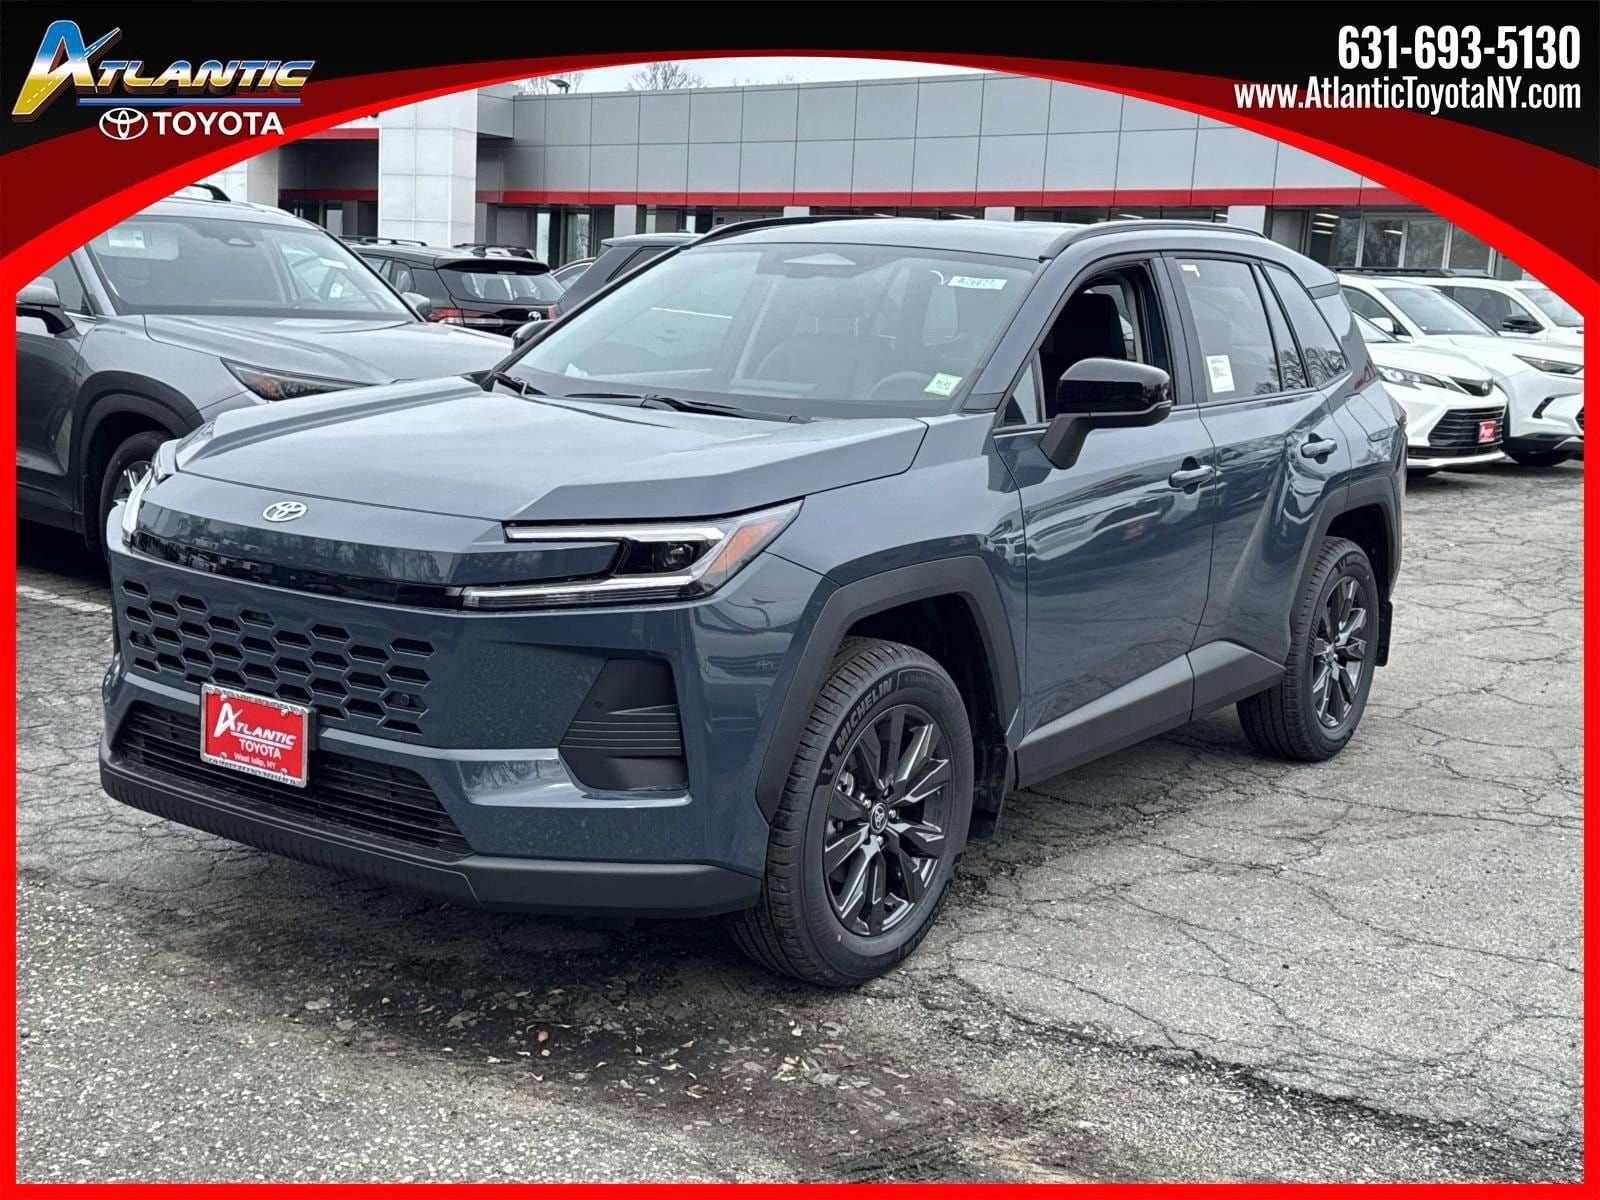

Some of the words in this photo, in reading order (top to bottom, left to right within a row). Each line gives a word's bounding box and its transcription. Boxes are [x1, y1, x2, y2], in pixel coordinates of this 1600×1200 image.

[213, 702, 297, 746] ATLANTIC
[835, 678, 893, 752] MICHELIN
[233, 752, 250, 763] West
[267, 761, 277, 770] NY
[239, 738, 282, 761] TOYOTA
